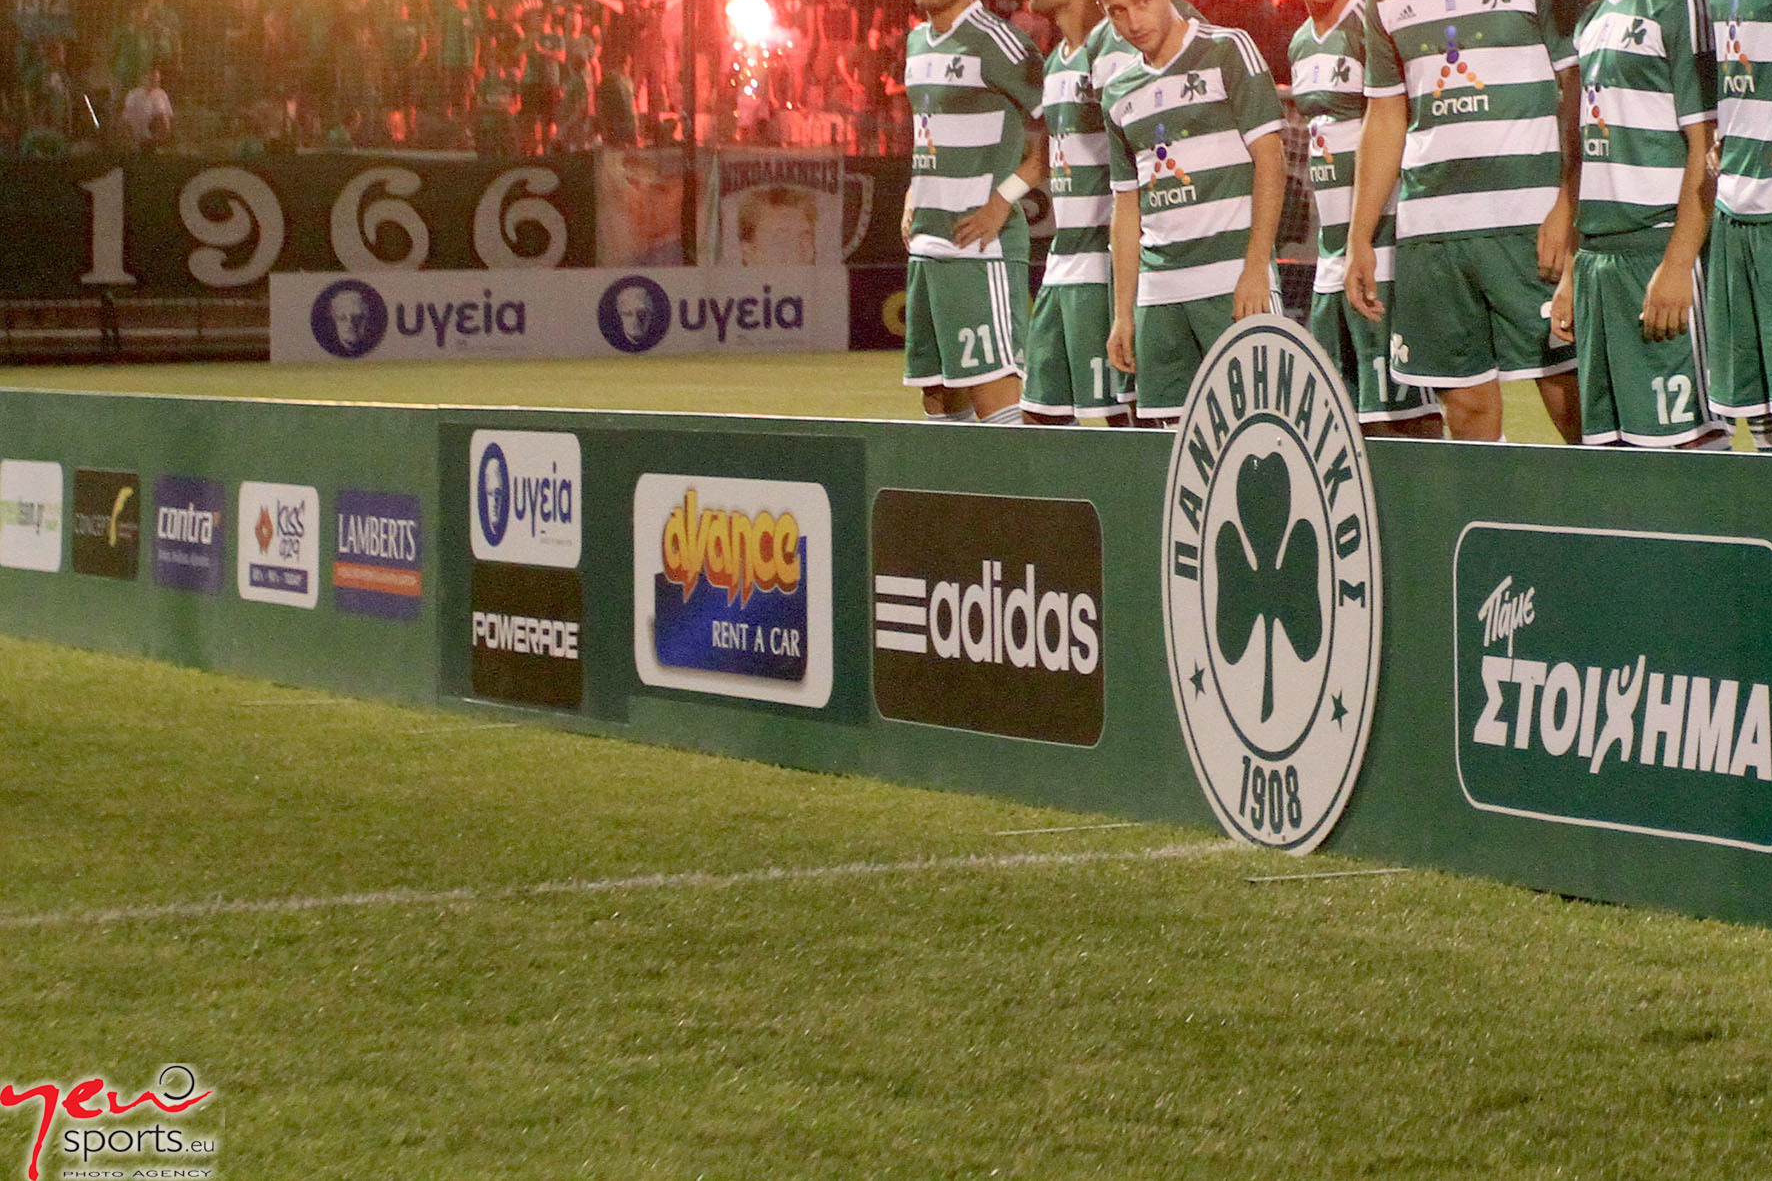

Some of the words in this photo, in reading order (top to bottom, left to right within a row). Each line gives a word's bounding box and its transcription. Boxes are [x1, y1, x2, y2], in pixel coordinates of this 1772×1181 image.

[80, 166, 568, 287] 1966
[957, 324, 998, 369] 21
[1650, 374, 1695, 425] 12
[158, 503, 213, 546] contra
[338, 513, 417, 562] LAMBERTS
[472, 612, 579, 659] POWERADE
[711, 620, 749, 651] RENT
[753, 626, 765, 654] A
[769, 627, 801, 657] CAR
[929, 559, 1099, 676] adidas
[1478, 575, 1536, 657] Πάμε
[1473, 654, 1772, 781] ΣΤΟΙΧΗΜΑ
[1239, 756, 1303, 835] 1908
